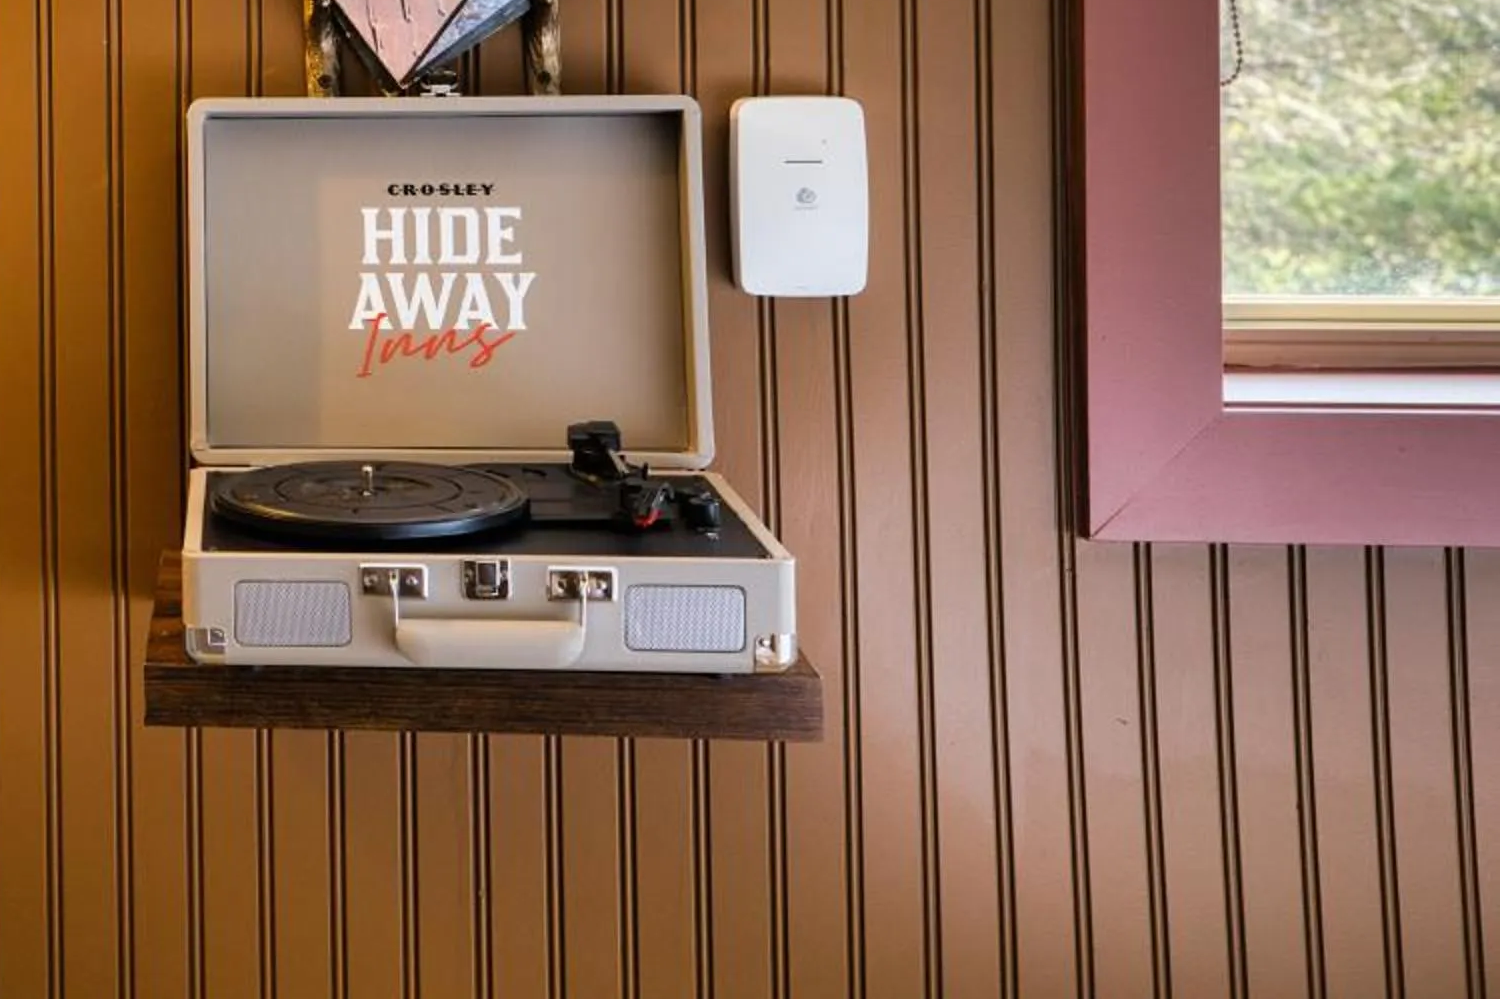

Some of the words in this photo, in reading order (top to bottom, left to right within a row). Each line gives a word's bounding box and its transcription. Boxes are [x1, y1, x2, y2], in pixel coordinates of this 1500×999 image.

[387, 183, 495, 196] CROSLEY
[360, 206, 523, 265] HIDE
[348, 272, 538, 330] AWAY
[355, 312, 517, 379] Inns
